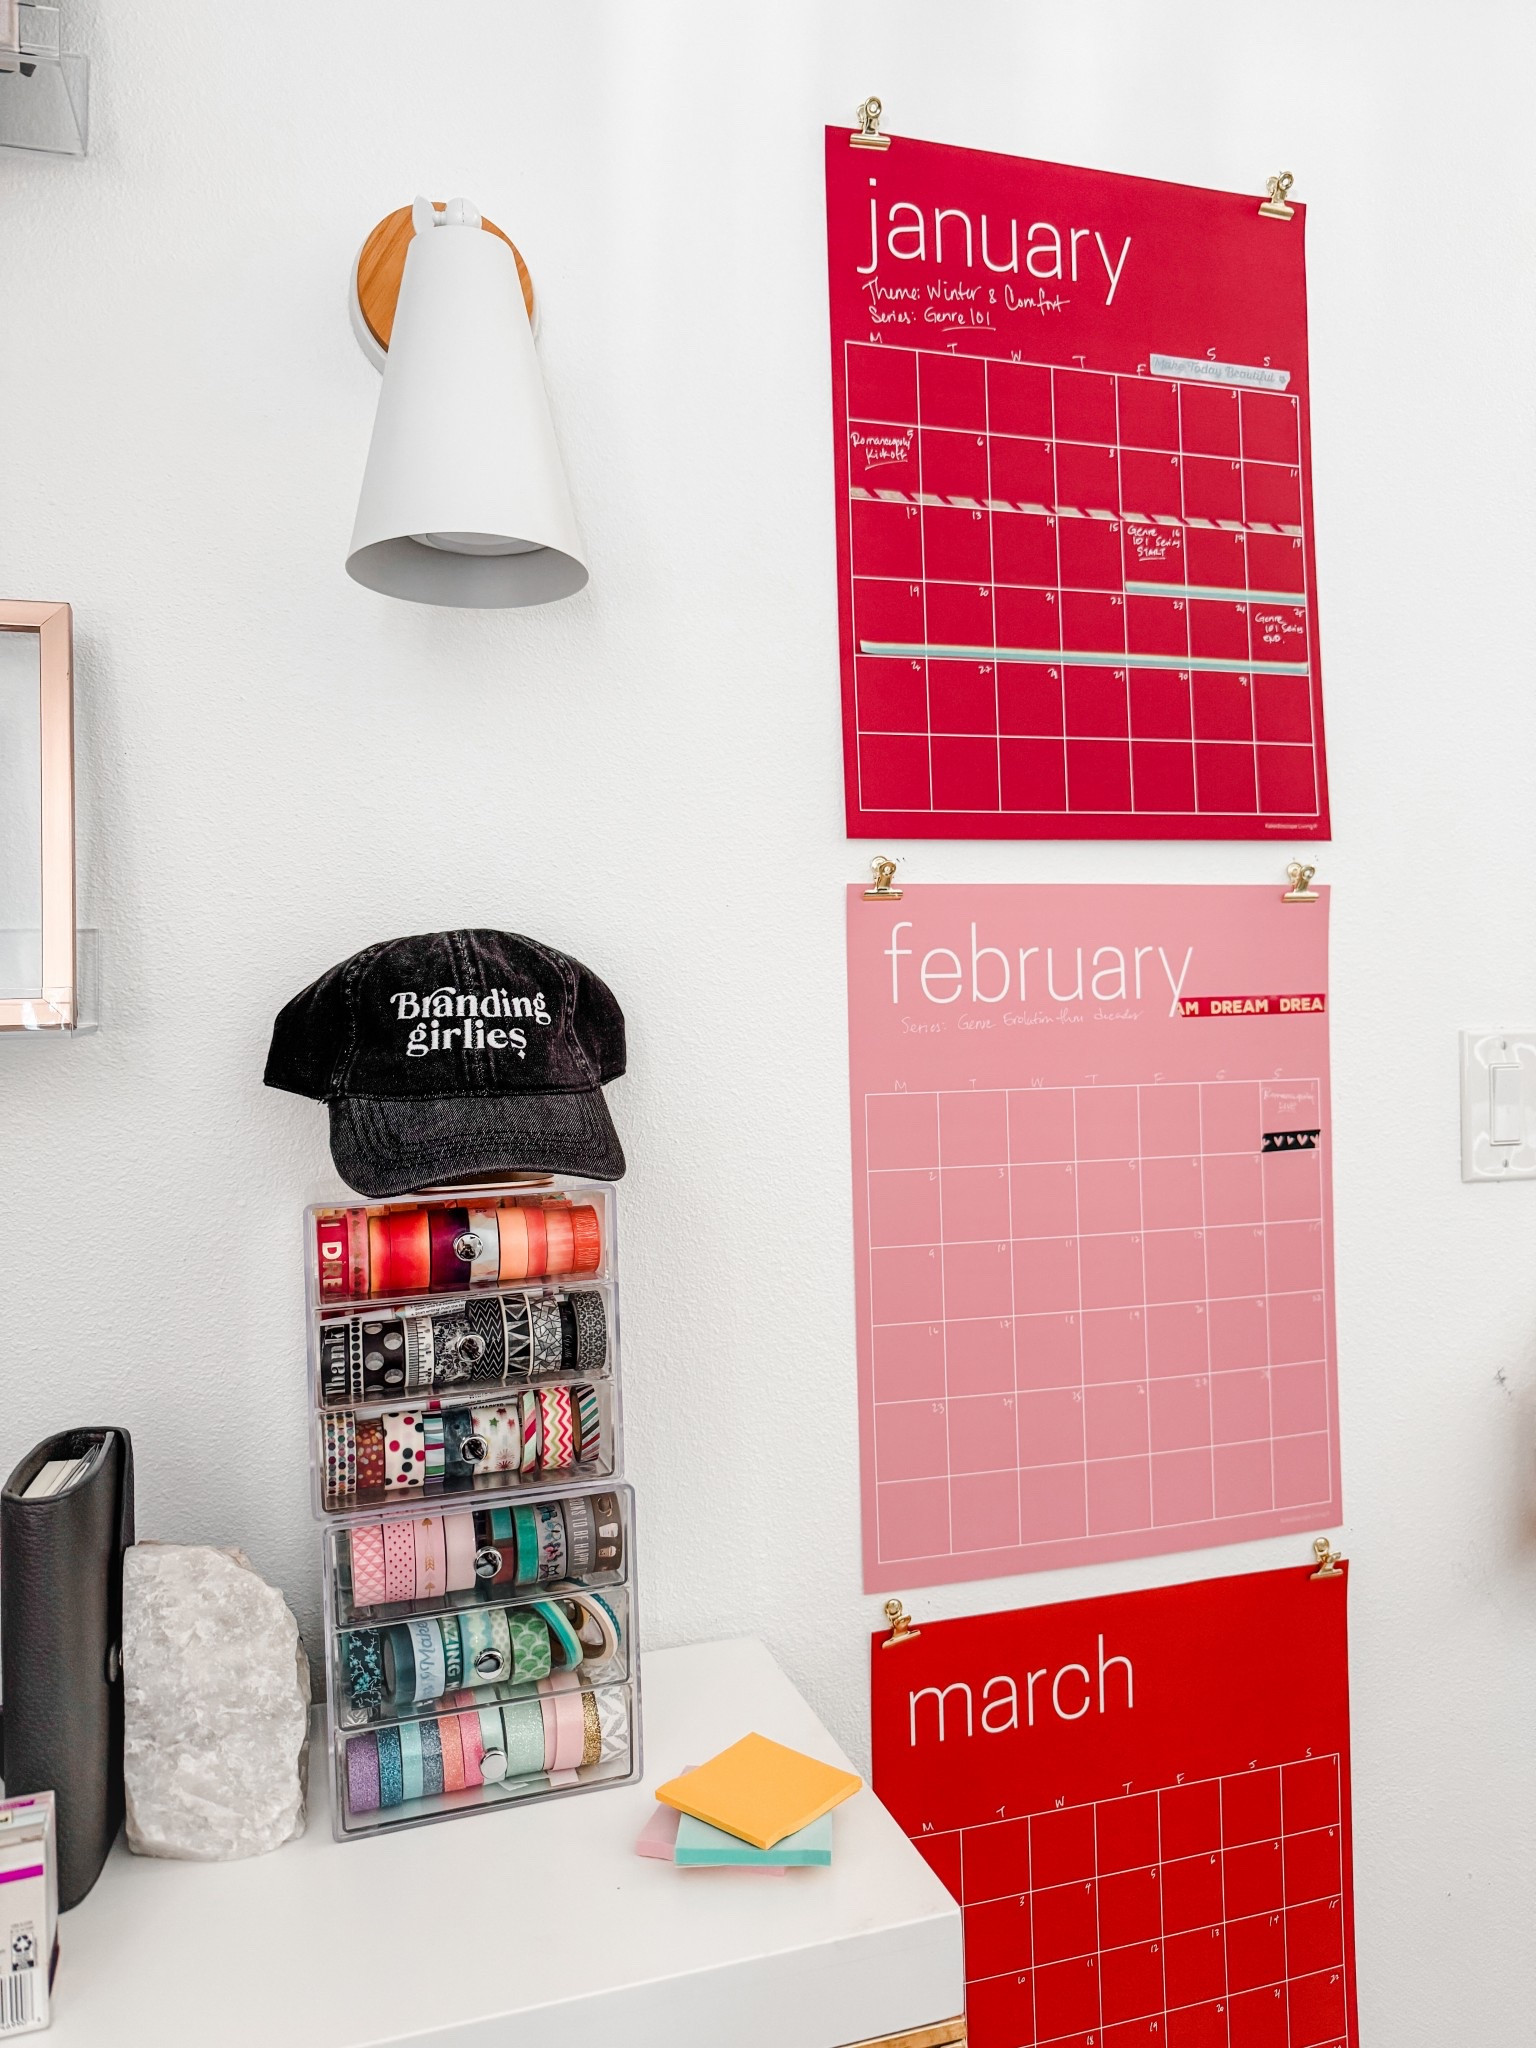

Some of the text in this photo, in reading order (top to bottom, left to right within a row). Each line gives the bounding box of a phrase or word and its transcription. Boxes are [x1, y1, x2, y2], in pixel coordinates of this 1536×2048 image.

[856, 178, 1131, 305] january
[862, 276, 1070, 315] Theme: Winter & Comfort
[869, 305, 990, 325] Series: Genre 101
[870, 332, 1270, 376] M T W T F S S
[1154, 356, 1275, 385] Make Today Beautiful
[1127, 525, 1157, 537] Genre
[1136, 546, 1166, 557] START
[1255, 612, 1284, 624] Genre
[884, 921, 1193, 1018] february
[390, 987, 551, 1025] Branding
[1210, 1000, 1269, 1015] DREAM
[1279, 997, 1323, 1012] DREA
[901, 1016, 947, 1034] Series:
[958, 1013, 997, 1030] Genre
[405, 1019, 527, 1058] girlies
[894, 1079, 907, 1093] M
[969, 1079, 977, 1089] T
[1031, 1076, 1044, 1088] W
[1085, 1074, 1098, 1085] T
[1154, 1072, 1165, 1084] F
[574, 1530, 589, 1541] BE
[574, 1543, 589, 1565] HAPPY
[908, 1634, 1133, 1747] march
[923, 1822, 934, 1831] M
[996, 1806, 1005, 1817] T
[1055, 1796, 1064, 1808] W
[1122, 1781, 1133, 1794] T
[1176, 1773, 1184, 1784] F
[1306, 1748, 1312, 1757] S
